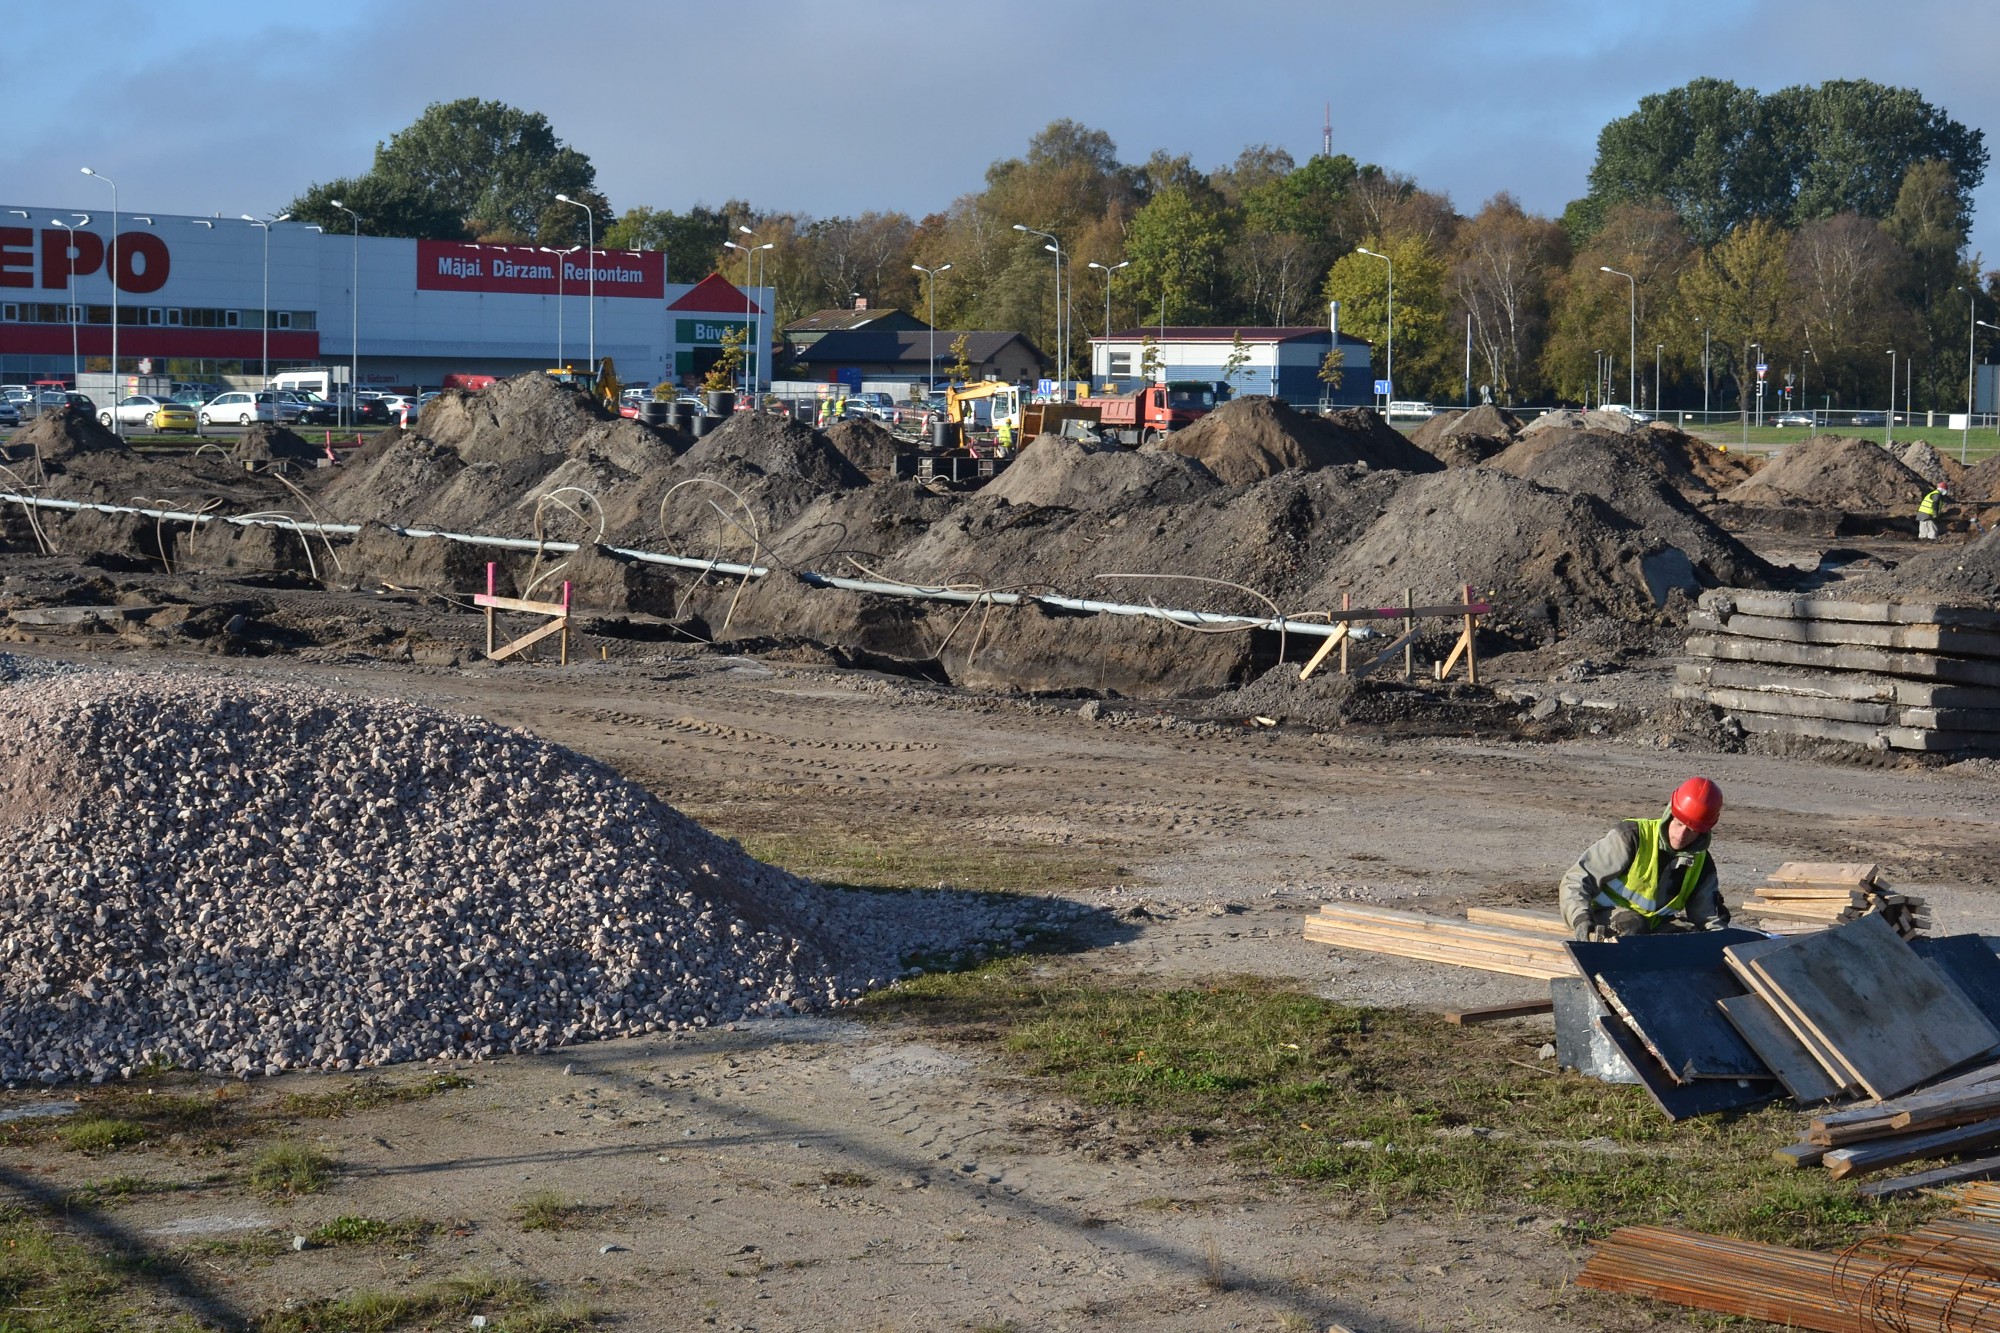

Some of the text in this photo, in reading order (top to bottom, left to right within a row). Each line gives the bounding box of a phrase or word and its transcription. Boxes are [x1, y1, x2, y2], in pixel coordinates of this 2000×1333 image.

[0, 227, 170, 293] EPO
[438, 257, 483, 279] Mājai.
[493, 260, 555, 279] Dārzam.
[695, 323, 734, 341] Būv
